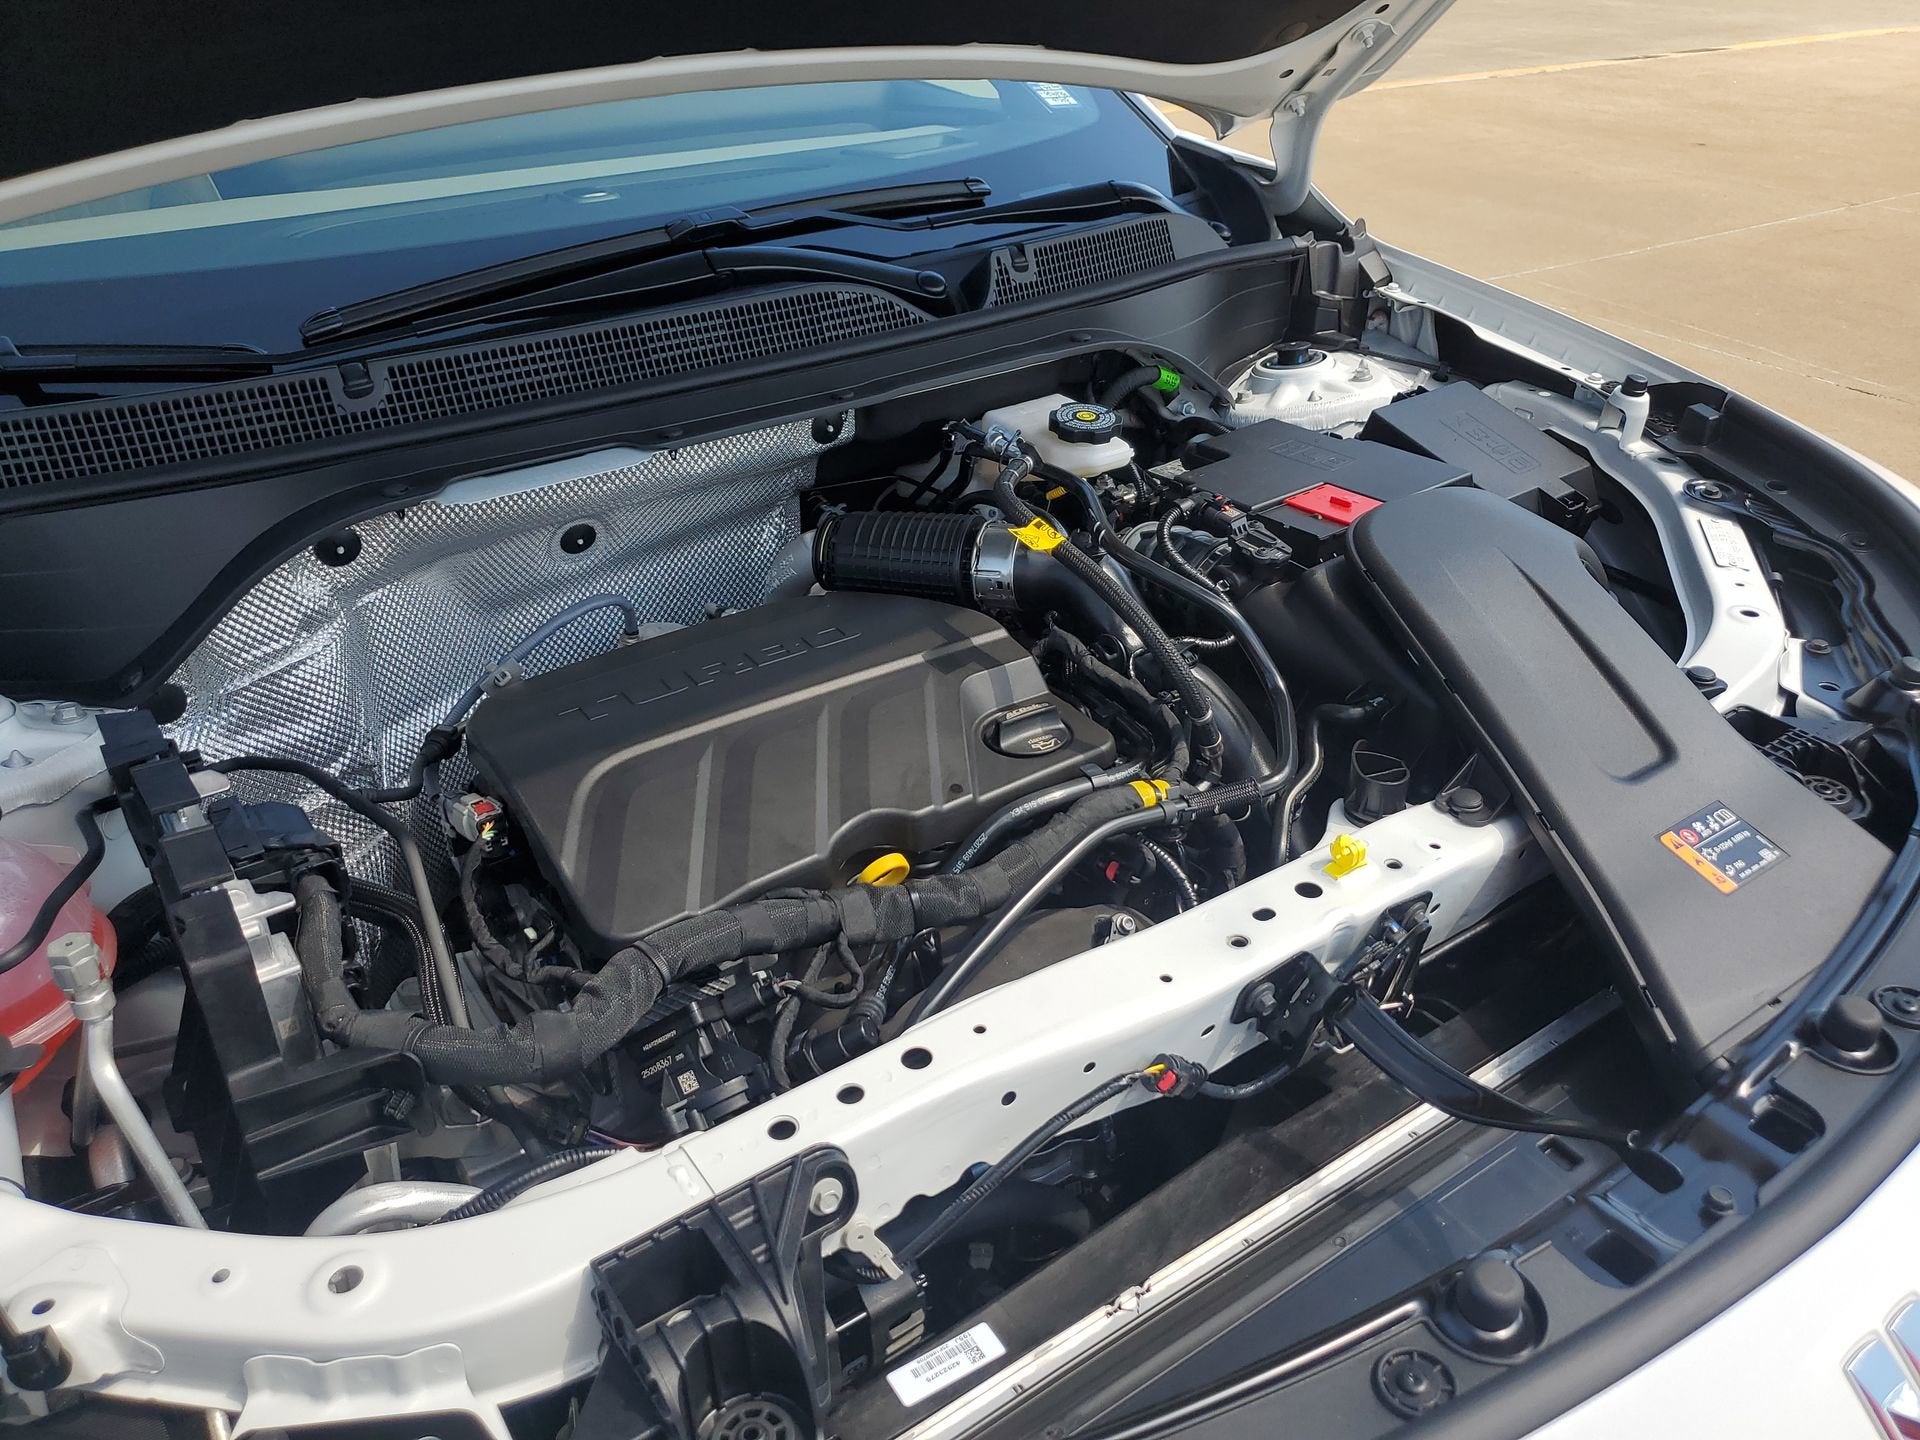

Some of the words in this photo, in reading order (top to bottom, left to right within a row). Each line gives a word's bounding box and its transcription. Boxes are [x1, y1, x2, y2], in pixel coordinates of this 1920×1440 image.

[557, 626, 863, 722] TURBO
[1005, 702, 1050, 720] ACDelco
[962, 831, 988, 862] 25207409
[640, 1055, 673, 1079] 25208367
